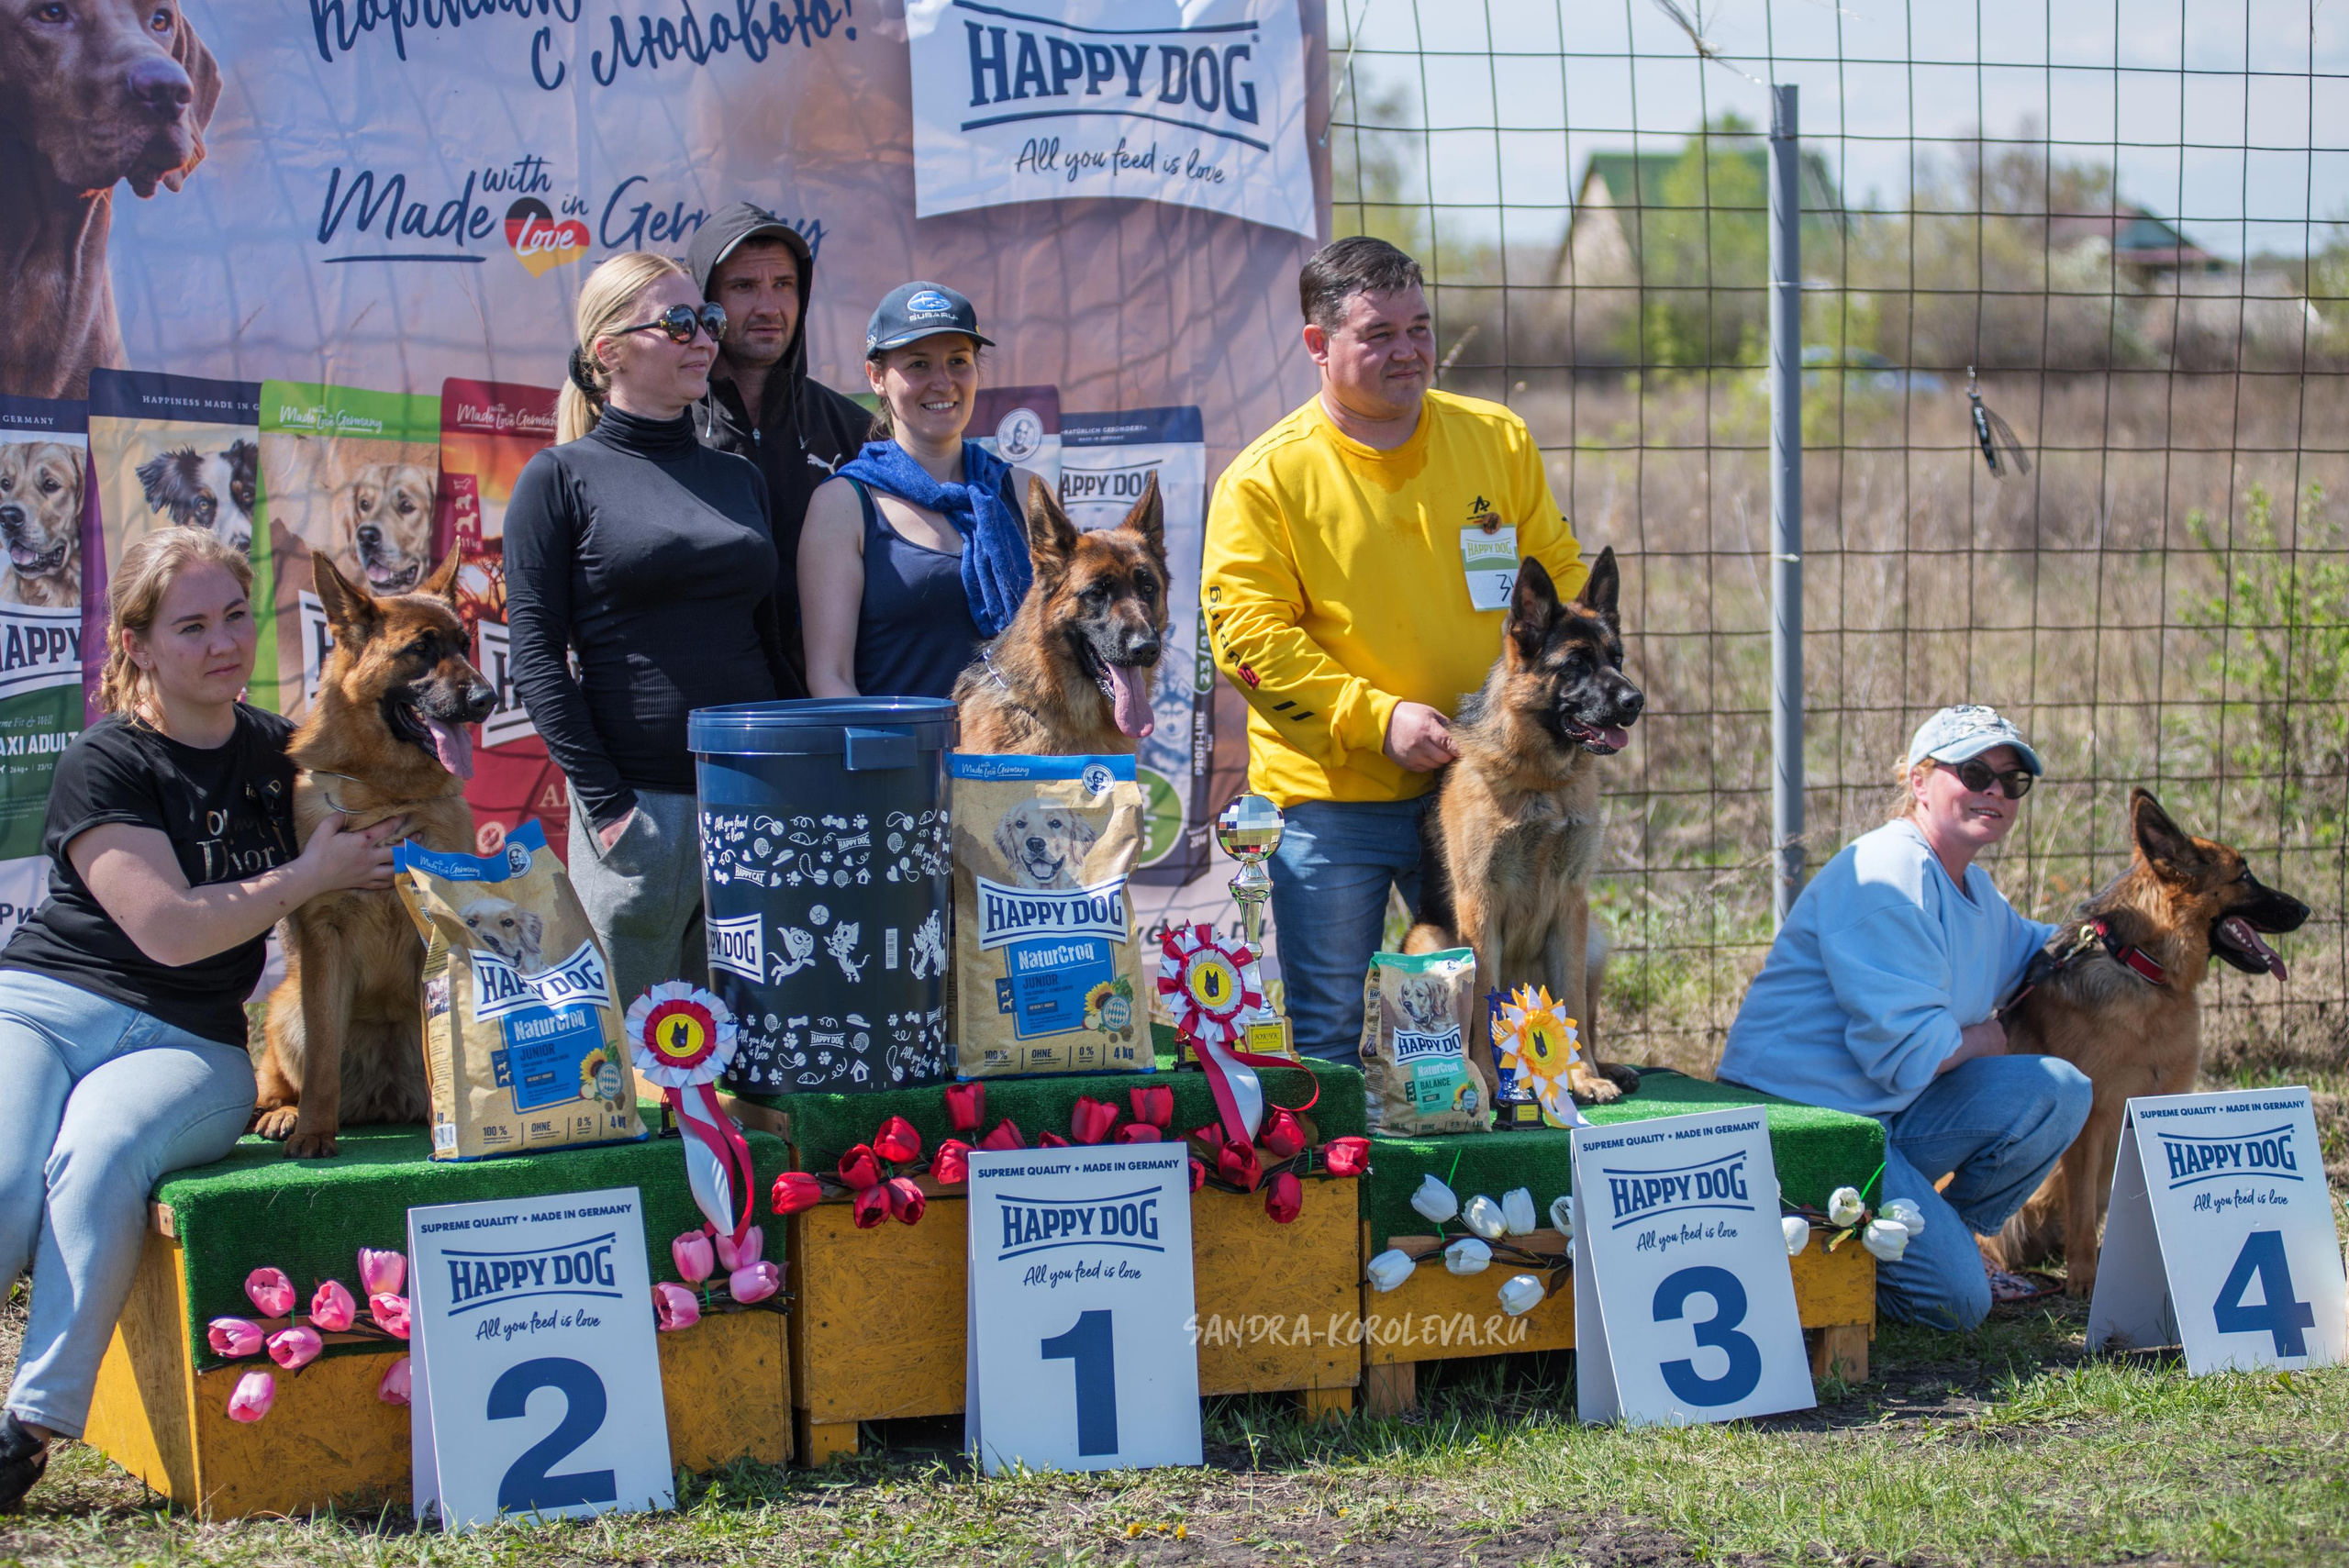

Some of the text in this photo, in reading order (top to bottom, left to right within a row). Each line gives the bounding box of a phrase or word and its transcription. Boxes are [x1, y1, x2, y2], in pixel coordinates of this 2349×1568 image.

[963, 19, 1151, 108] HAPPY
[1016, 136, 1226, 183] All you feed is love
[317, 153, 829, 263] Made with Love in Gery
[908, 312, 956, 321] SUBARU
[142, 395, 200, 407] HAPPINESS
[205, 399, 233, 409] MADE
[237, 401, 249, 410] IN
[3, 414, 54, 425] GERMANY
[279, 405, 316, 424] Made
[316, 414, 334, 429] Love
[336, 409, 382, 432] Germany
[457, 404, 495, 424] Made
[496, 414, 515, 429] Love
[1062, 473, 1109, 496] APPY
[1467, 541, 1512, 556] HAPPY DOG
[0, 624, 81, 673] APPY
[37, 715, 53, 726] Well
[1195, 710, 1206, 776] PROFI-LINE
[962, 763, 983, 774] Made
[997, 763, 1030, 776] Germany
[715, 815, 724, 831] All
[734, 815, 749, 829] feed
[838, 835, 870, 851] HAPPY DOG
[911, 842, 925, 857] All
[419, 855, 481, 877] Made Germany
[735, 866, 765, 884] HAPPY CAT
[985, 888, 1123, 933] HAPPY DOG
[723, 929, 756, 966] DOG
[1018, 942, 1095, 970] NaturCroq
[555, 959, 606, 997] DOG
[1022, 973, 1059, 989] JUNIOR
[513, 1009, 586, 1042] NaturCroq
[738, 1029, 749, 1044] All
[759, 1035, 776, 1051] feed
[810, 1033, 844, 1045] HAPPY DOG
[1397, 1033, 1462, 1057] HAPPY DO
[519, 1043, 555, 1062] JUNIOR
[754, 1046, 769, 1060] love
[900, 1046, 914, 1060] All
[985, 1050, 1008, 1060] 100 %
[1031, 1049, 1052, 1058] OHNE
[1086, 1046, 1094, 1056] %
[1113, 1046, 1134, 1060] 4 kg
[1418, 1062, 1459, 1077] NaturCroq
[1419, 1077, 1452, 1090] BALANCE
[2140, 1100, 2305, 1118] SUPREME QUALITY MADE IN GERMANY
[483, 1125, 508, 1137] 100 %
[531, 1121, 551, 1132] OHNE
[584, 1117, 592, 1126] %
[610, 1116, 627, 1129] 4 kg
[1583, 1121, 1760, 1151] SUPREME QUALITY MADE IN GERMANY
[2164, 1135, 2298, 1180] HAPPY DOG
[978, 1160, 1179, 1178] SUPREME QUALITY MADE IN GERMANY
[1609, 1162, 1749, 1218] HAPPY DOG
[2193, 1189, 2289, 1213] All you feed is love
[420, 1204, 631, 1233] SUPREME QUALITY MADE IN GERMANY
[1000, 1198, 1158, 1249] HAPPY DOG
[1636, 1221, 1738, 1252] All you feed is love
[448, 1245, 616, 1304] HAPPY DOG
[1023, 1260, 1141, 1288] All you feed is love
[2213, 1229, 2315, 1358] 4
[475, 1308, 601, 1341] All you feed is love
[1653, 1265, 1762, 1407] 3
[1041, 1309, 1119, 1457] 1
[486, 1356, 618, 1513] 2
